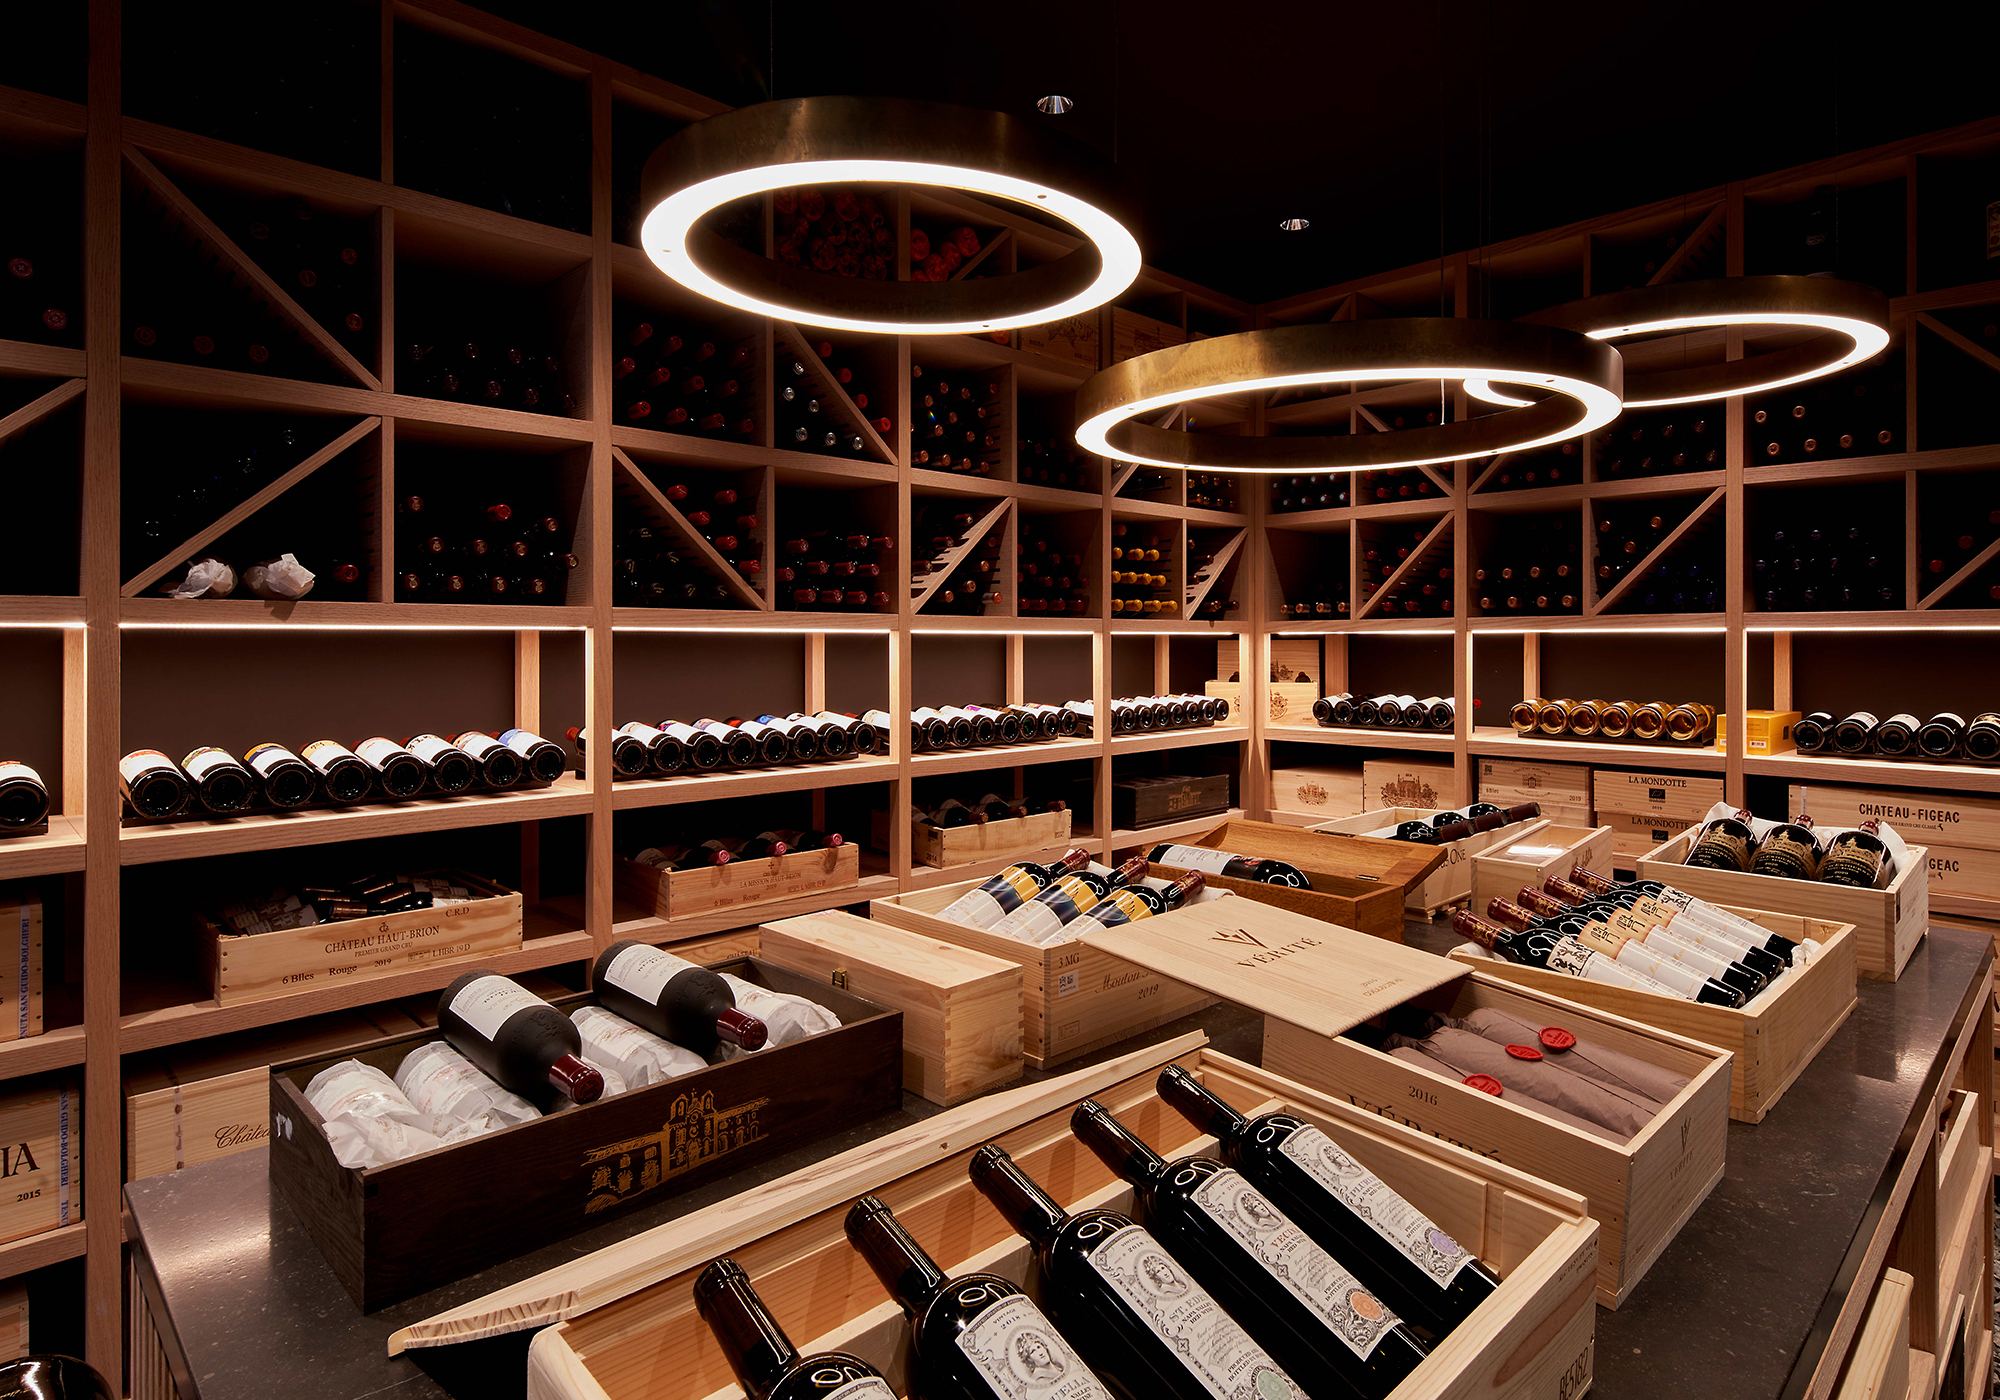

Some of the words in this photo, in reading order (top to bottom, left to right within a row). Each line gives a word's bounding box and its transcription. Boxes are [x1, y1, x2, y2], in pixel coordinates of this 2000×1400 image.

[1628, 775, 1640, 784] LA
[1641, 776, 1688, 788] MONDOTTE
[1631, 816, 1643, 825] LA
[1643, 817, 1690, 830] MONDOTTE
[324, 935, 376, 954] CHÂTEAU
[377, 924, 441, 945] HAUT-BRION
[354, 947, 381, 958] PREMIER
[380, 944, 401, 953] GRAND
[400, 941, 413, 950] CRU
[374, 958, 393, 968] 2019
[1064, 952, 1080, 967] MG
[281, 975, 289, 985] 6
[329, 965, 358, 976] Rouge
[1136, 983, 1160, 1001] 2019
[1407, 1084, 1439, 1107] 2016
[16, 1189, 41, 1202] 2015
[992, 1307, 1017, 1325] VINTAGE
[1000, 1315, 1021, 1330] 2018
[1189, 1313, 1202, 1324] RED
[1050, 1375, 1092, 1400] UELLA
